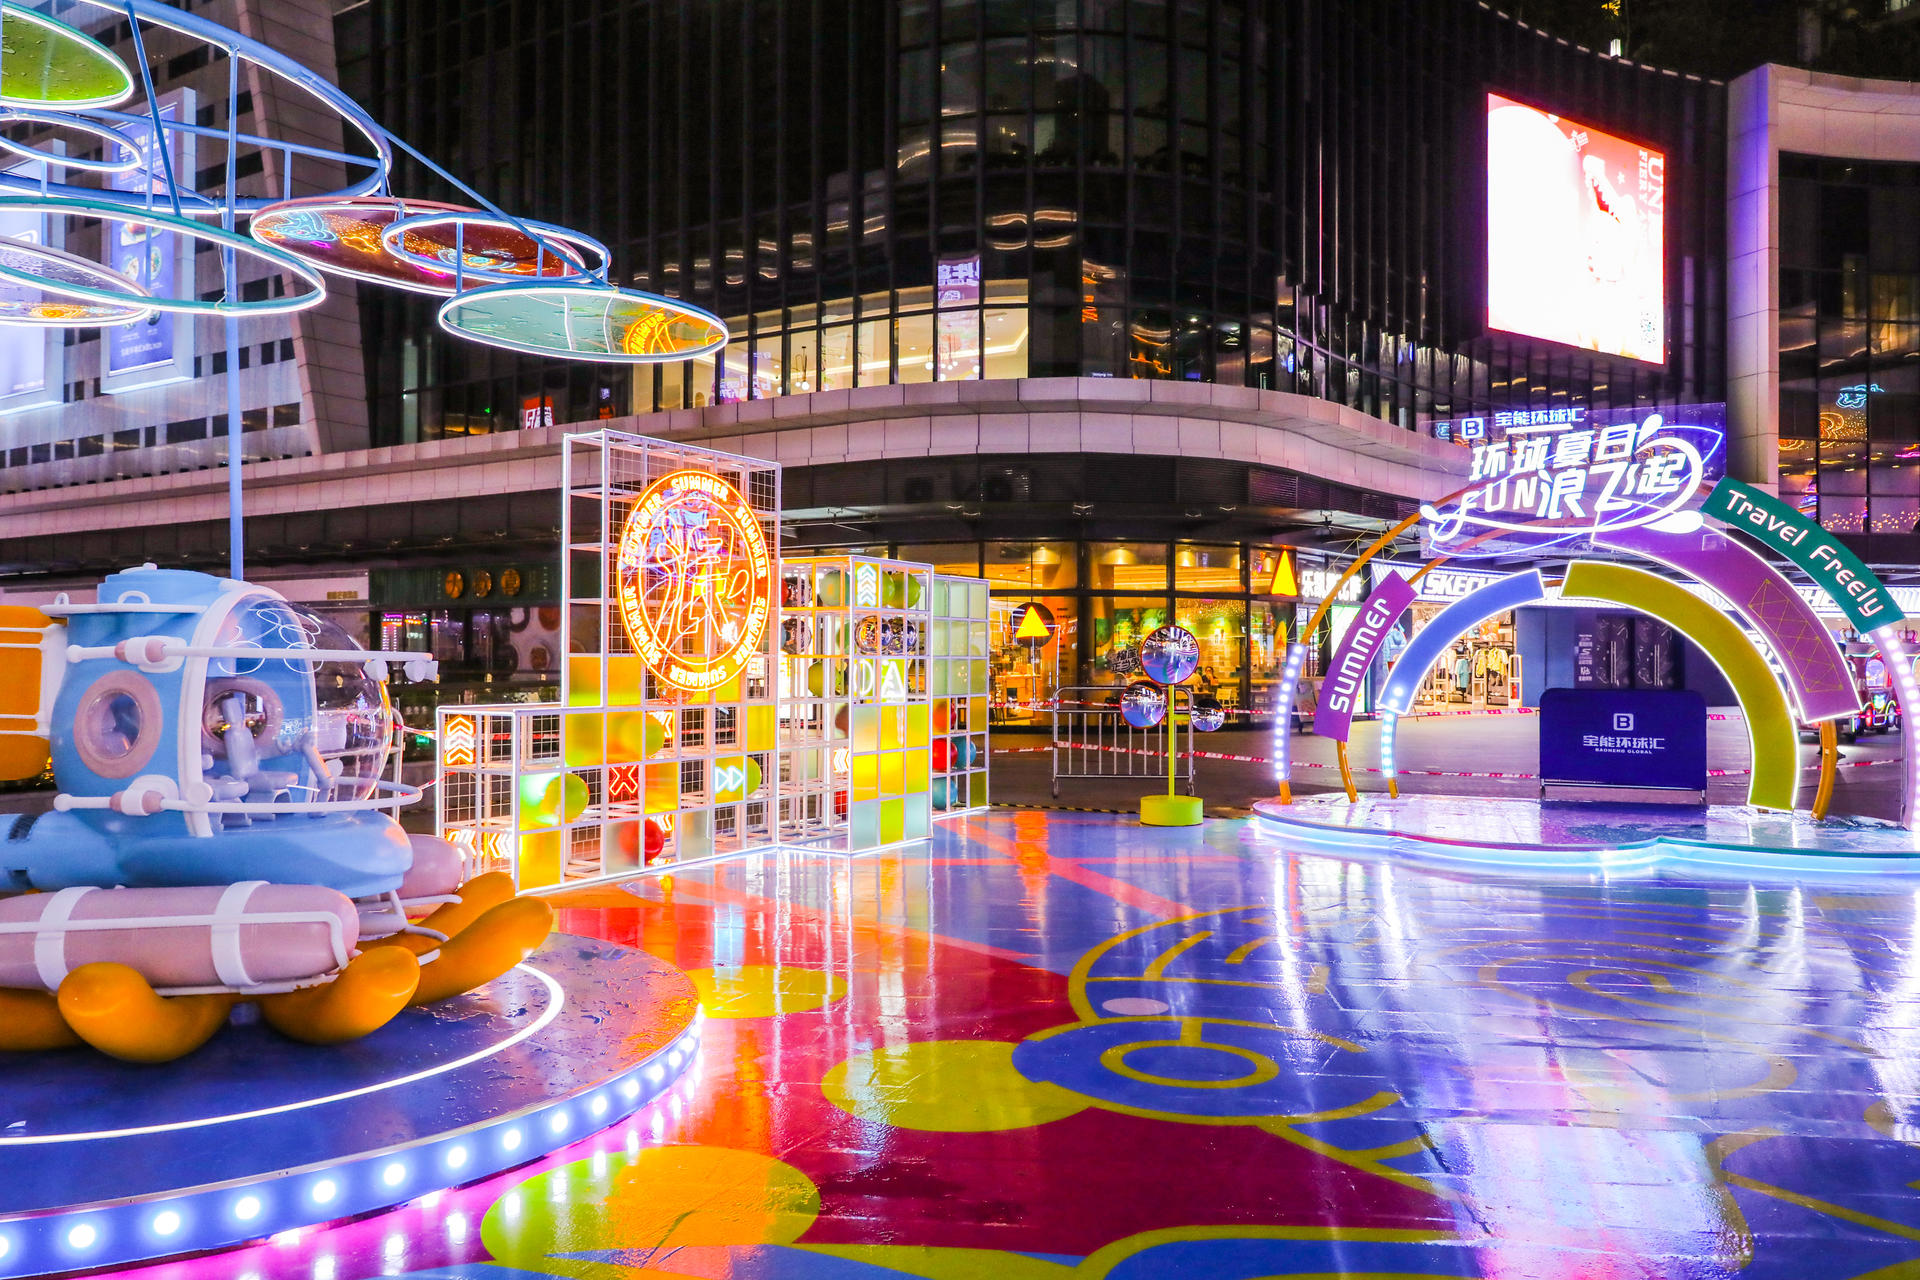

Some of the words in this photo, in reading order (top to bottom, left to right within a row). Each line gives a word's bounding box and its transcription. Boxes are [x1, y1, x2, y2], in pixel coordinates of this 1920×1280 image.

[1495, 407, 1585, 427] 宝能环球汇
[1468, 423, 1638, 481] 环球夏日
[670, 475, 730, 502] SUMMER
[735, 506, 767, 579] SUMMER
[1726, 489, 1809, 547] Travel
[1808, 544, 1885, 618] Freely
[624, 585, 663, 667] SUMMER
[669, 664, 727, 686] SUMMER
[1582, 734, 1666, 750] 宝能环球汇
